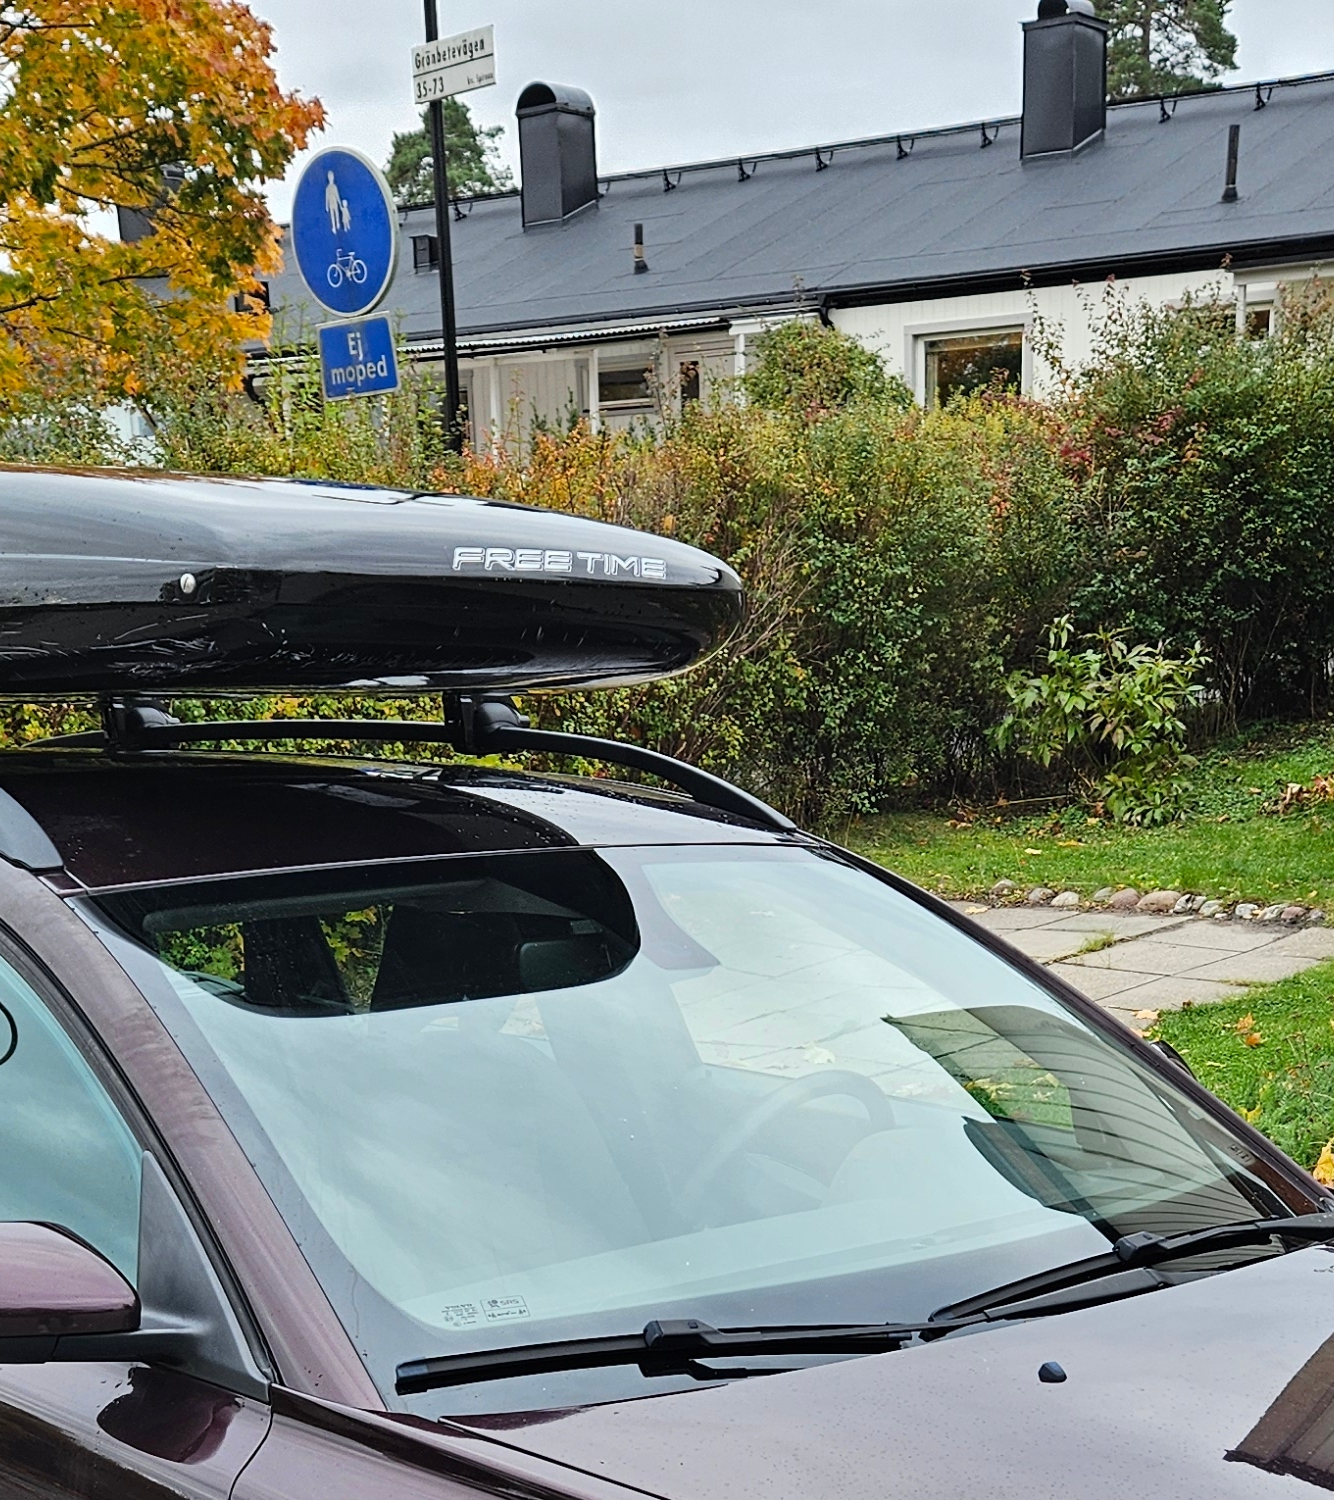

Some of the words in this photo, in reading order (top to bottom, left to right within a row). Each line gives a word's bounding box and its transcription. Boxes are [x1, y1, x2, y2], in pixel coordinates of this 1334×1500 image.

[414, 38, 485, 70] Grönbetevägen
[416, 76, 445, 99] 35-73
[347, 332, 364, 361] Ej
[331, 355, 388, 387] moped
[452, 546, 573, 573] FREE
[577, 551, 667, 580] TIME
